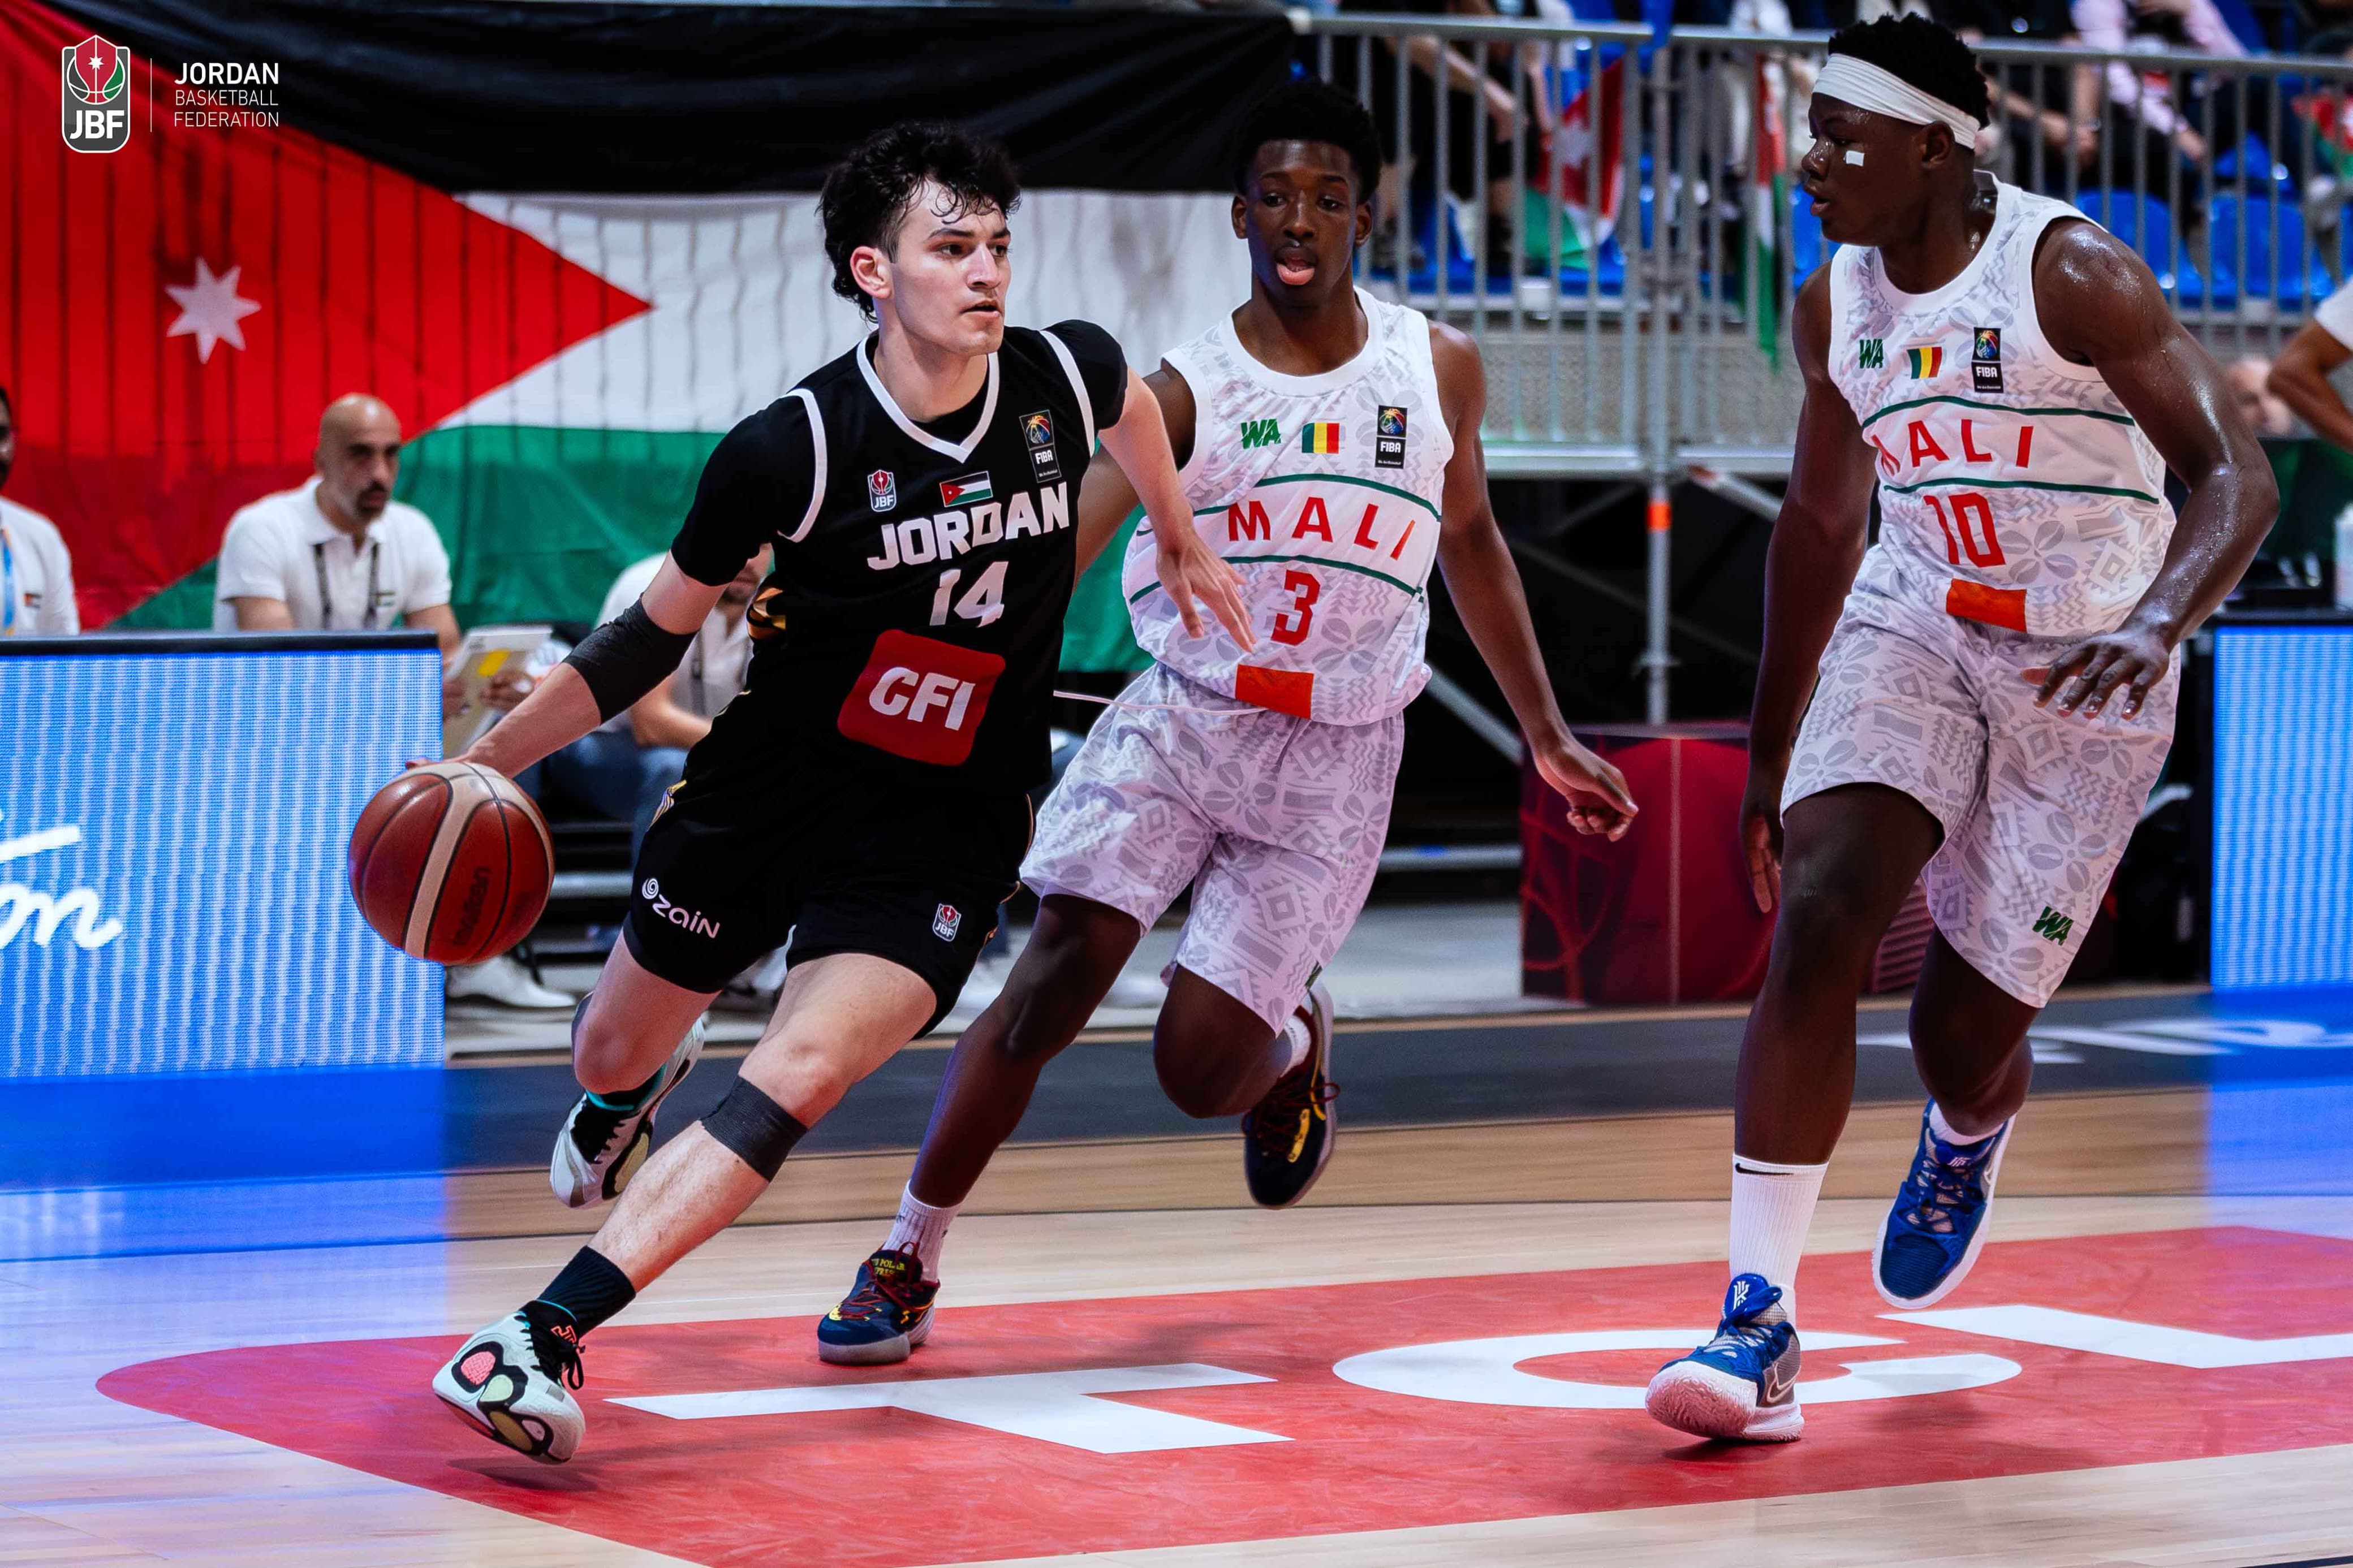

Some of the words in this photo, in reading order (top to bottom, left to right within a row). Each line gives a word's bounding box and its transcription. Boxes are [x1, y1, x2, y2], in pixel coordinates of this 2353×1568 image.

[1976, 366, 1998, 378] FIBA
[1240, 418, 1281, 449] WA
[1380, 442, 1401, 453] FIBA
[1035, 450, 1053, 464] FIBA
[874, 495, 894, 508] JBF
[867, 482, 1070, 570] JORDAN
[1227, 496, 1416, 561] MALI
[1923, 493, 2006, 568] 10
[929, 561, 1009, 628] 14
[1270, 569, 1321, 646] 3
[869, 667, 976, 731] CFI
[652, 893, 720, 939] zain
[935, 922, 954, 937] JBF
